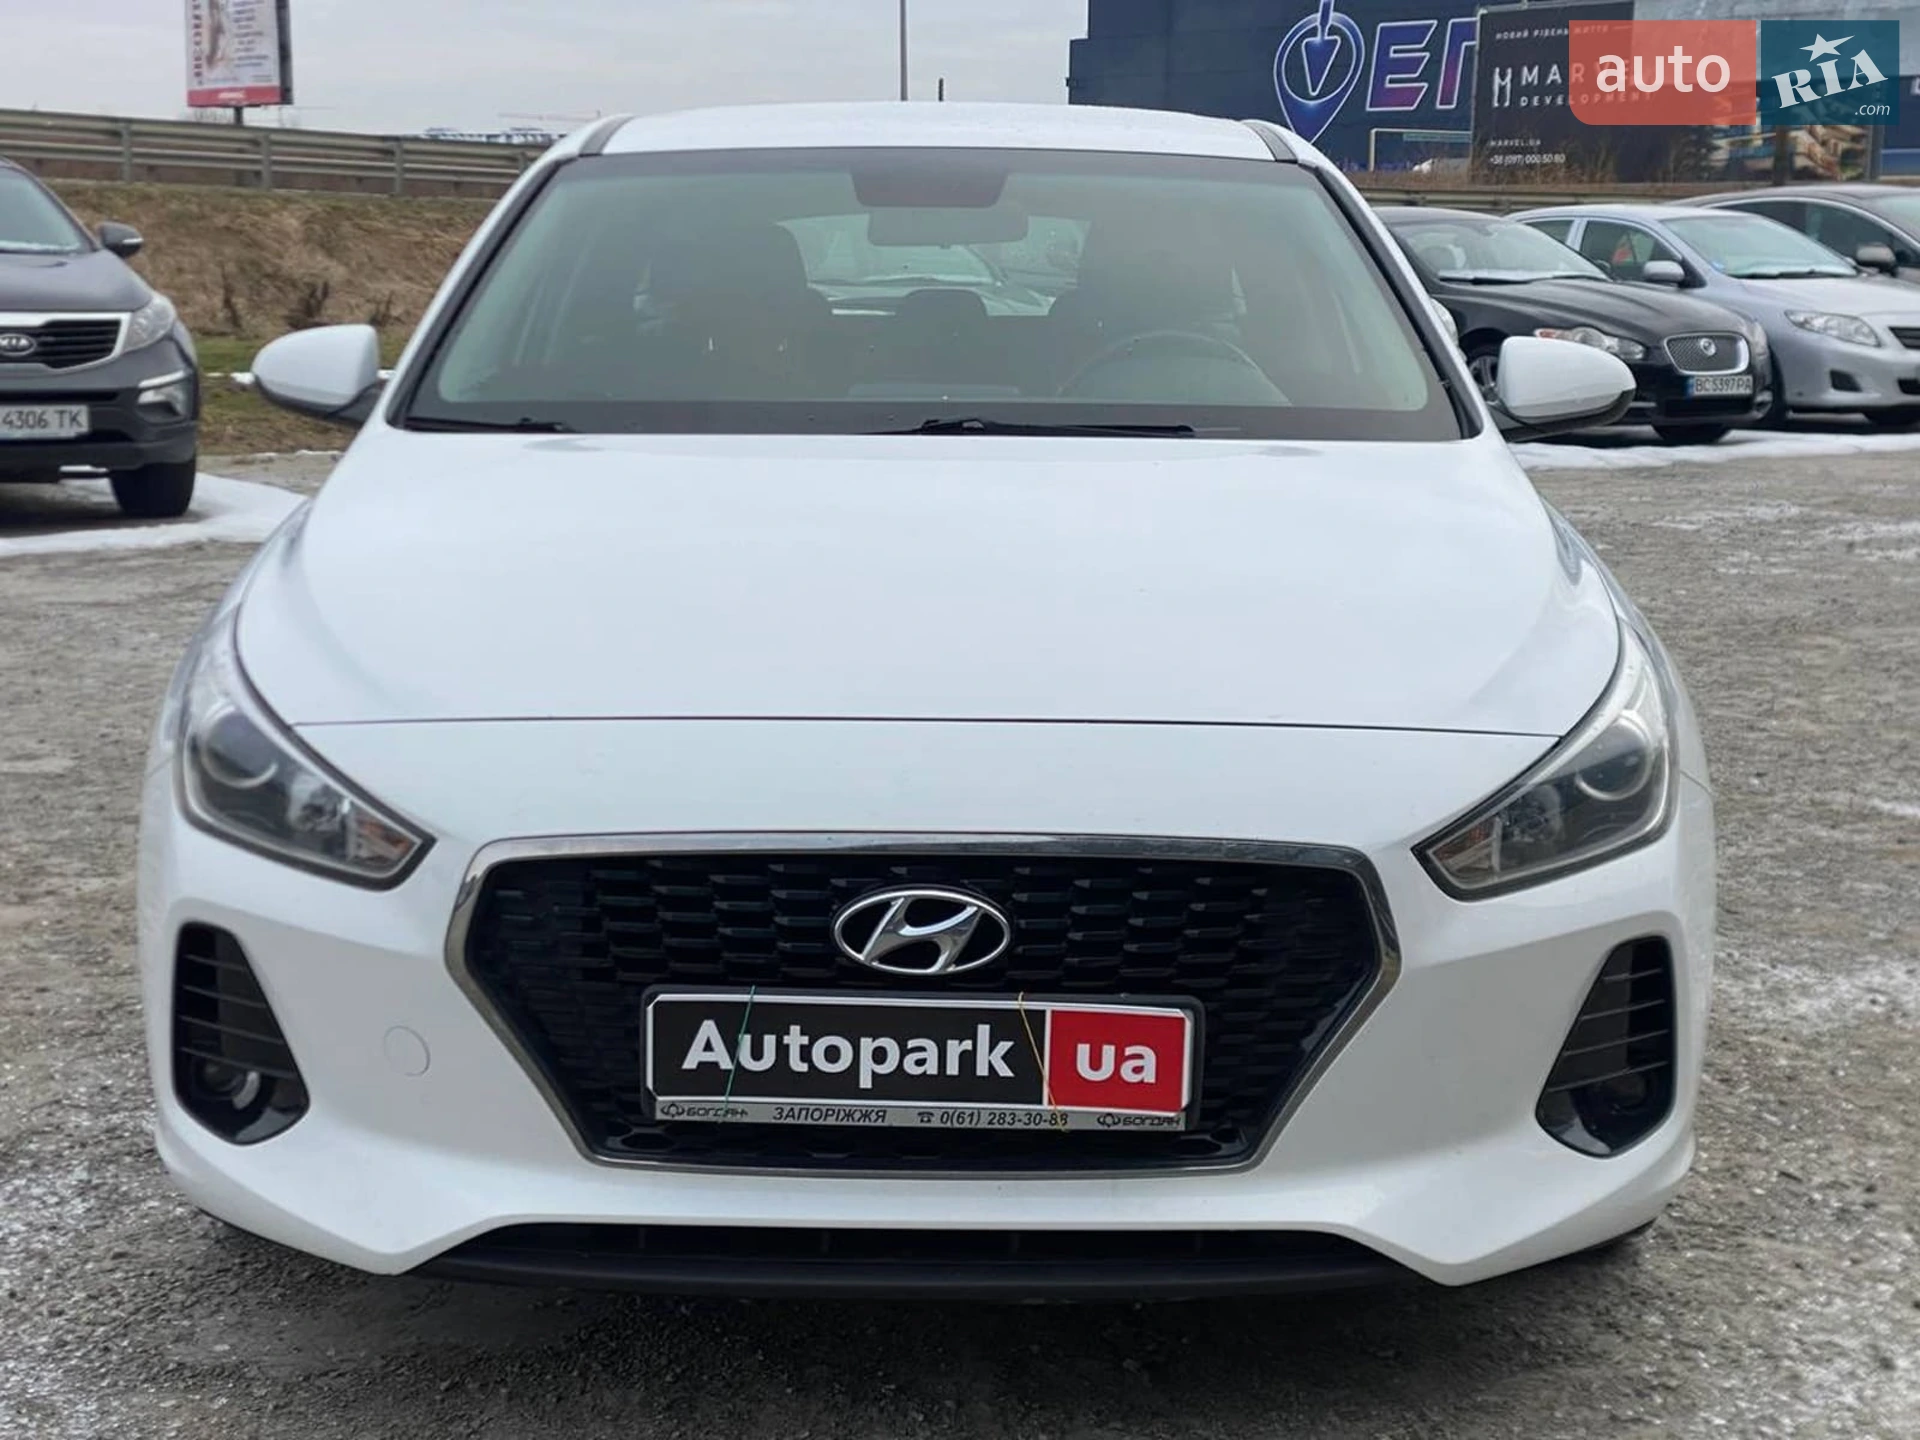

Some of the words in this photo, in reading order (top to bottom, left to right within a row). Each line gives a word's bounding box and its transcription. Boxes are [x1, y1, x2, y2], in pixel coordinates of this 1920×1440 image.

[3, 410, 49, 429] 4306
[55, 410, 83, 429] TK
[681, 1018, 1015, 1090] Autopark
[1075, 1042, 1157, 1084] ua
[772, 1106, 888, 1124] ЗАПОРІЖЖЯ
[940, 1110, 981, 1128] 0(61)
